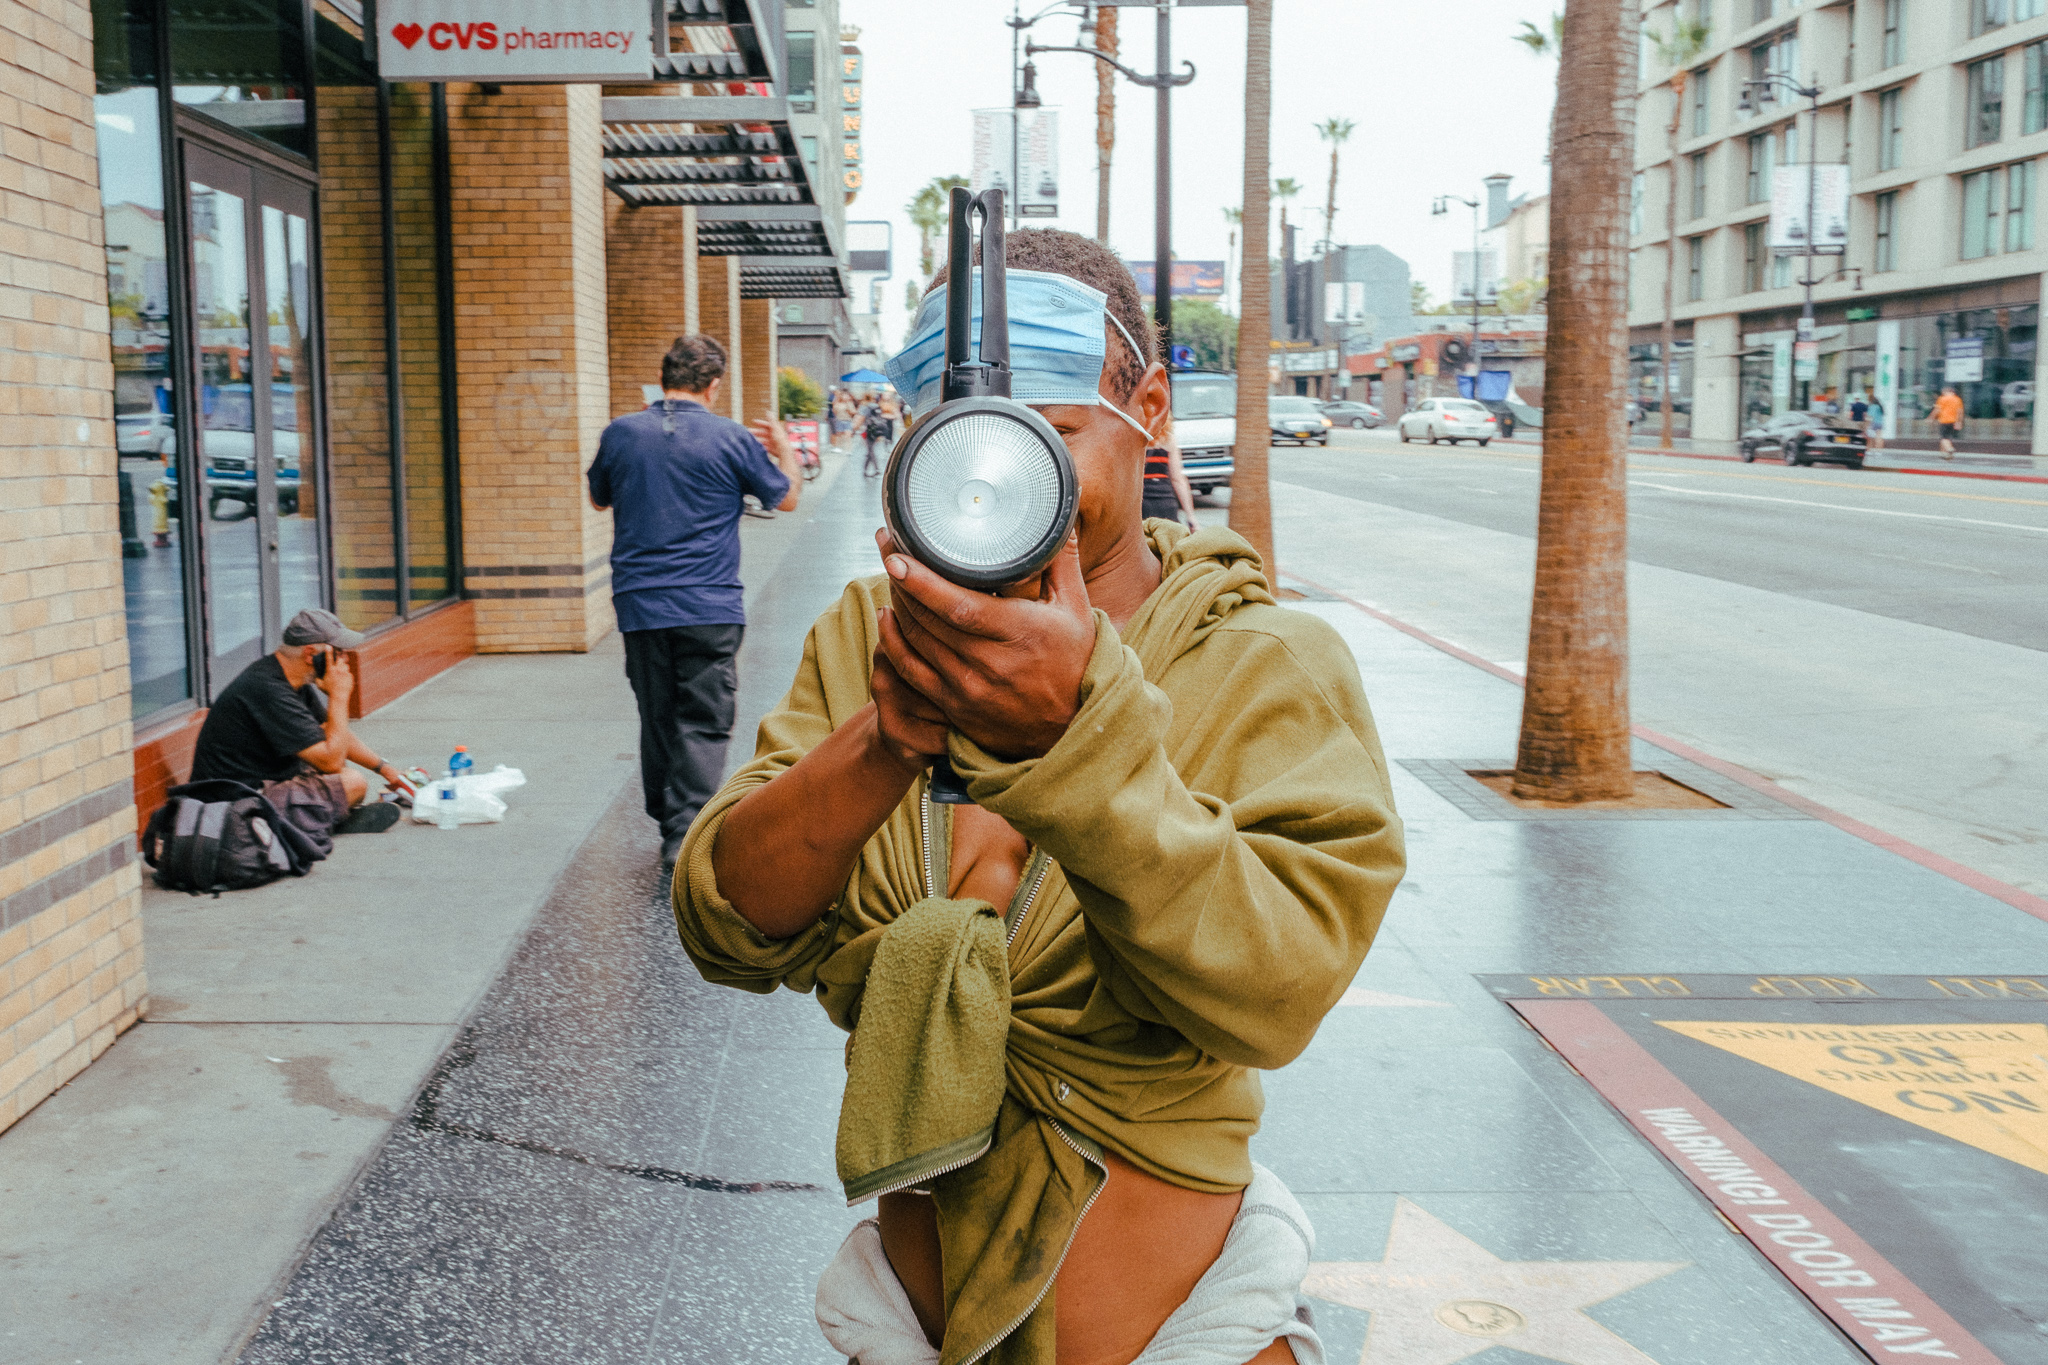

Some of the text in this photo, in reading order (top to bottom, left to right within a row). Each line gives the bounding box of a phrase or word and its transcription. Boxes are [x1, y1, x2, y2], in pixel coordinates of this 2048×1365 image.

[427, 22, 634, 54] CVS pharmacy
[843, 58, 862, 189] FUNKO
[1528, 975, 1692, 996] CLEAR
[1927, 977, 2048, 998] EXIT
[1706, 1027, 2025, 1044] PEDESTRIANS
[1828, 1044, 1966, 1068] NO
[1815, 1068, 2037, 1084] PARKING
[1895, 1089, 2043, 1113] NO
[1640, 1106, 1961, 1359] WARNING! DOOR MAY
